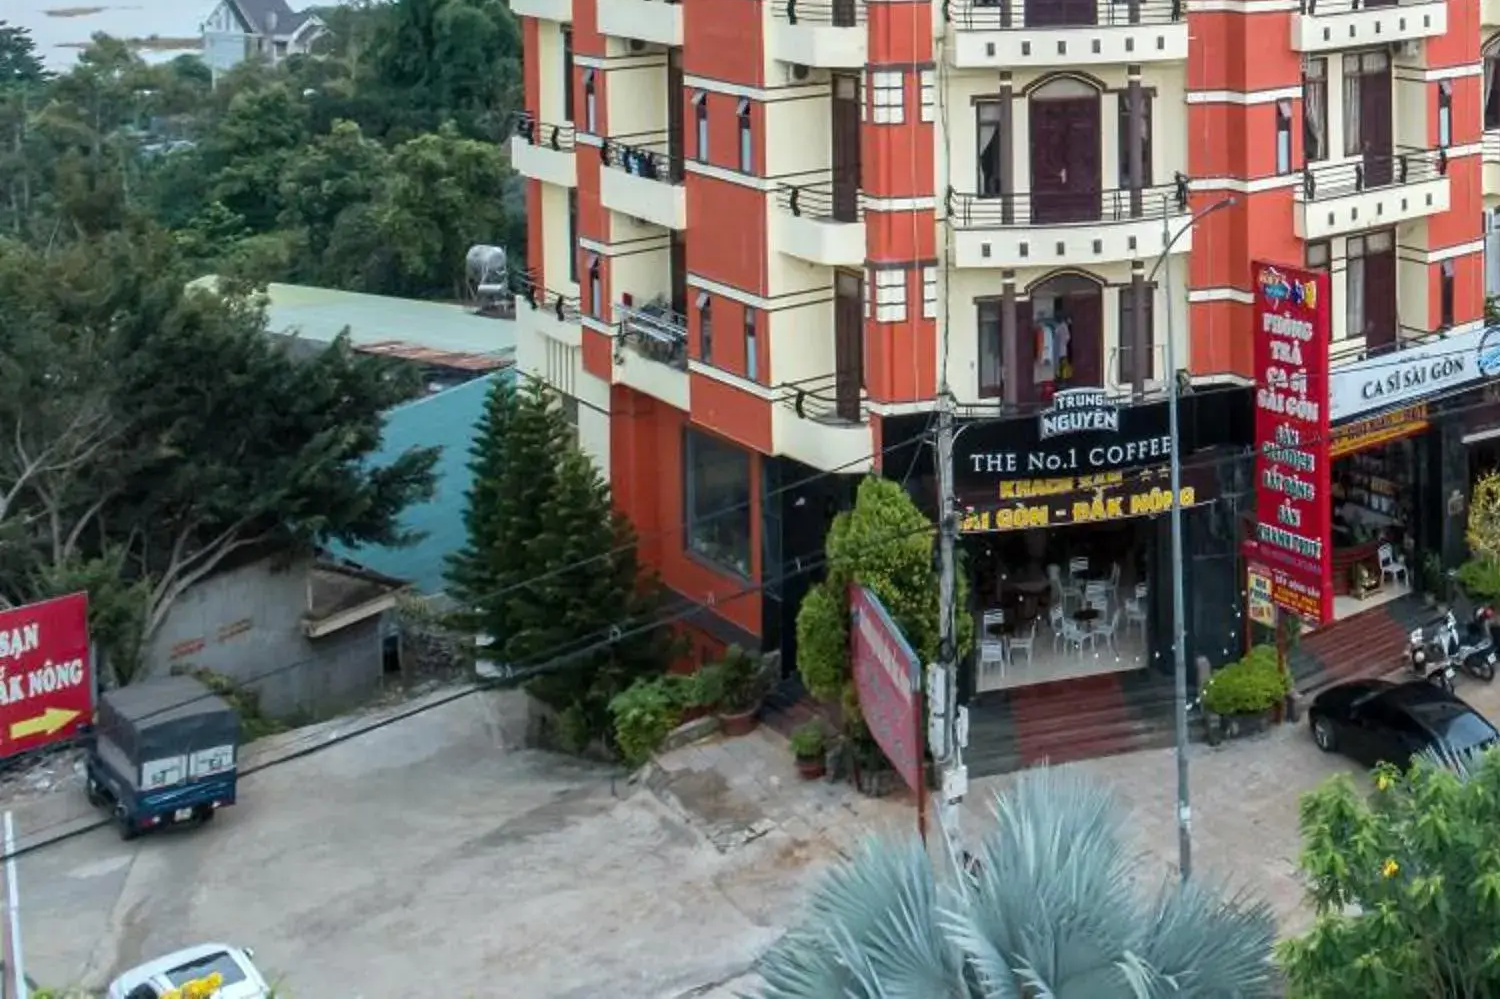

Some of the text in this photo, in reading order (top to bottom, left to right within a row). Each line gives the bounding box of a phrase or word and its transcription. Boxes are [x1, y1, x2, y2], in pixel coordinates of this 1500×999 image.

[1362, 379, 1384, 399] CA
[1403, 366, 1427, 388] SÀI
[1431, 356, 1465, 380] GÒN
[1056, 394, 1103, 410] TRUNG
[970, 435, 1172, 473] THE No.1 COFFEE
[28, 658, 84, 698] NÔNG
